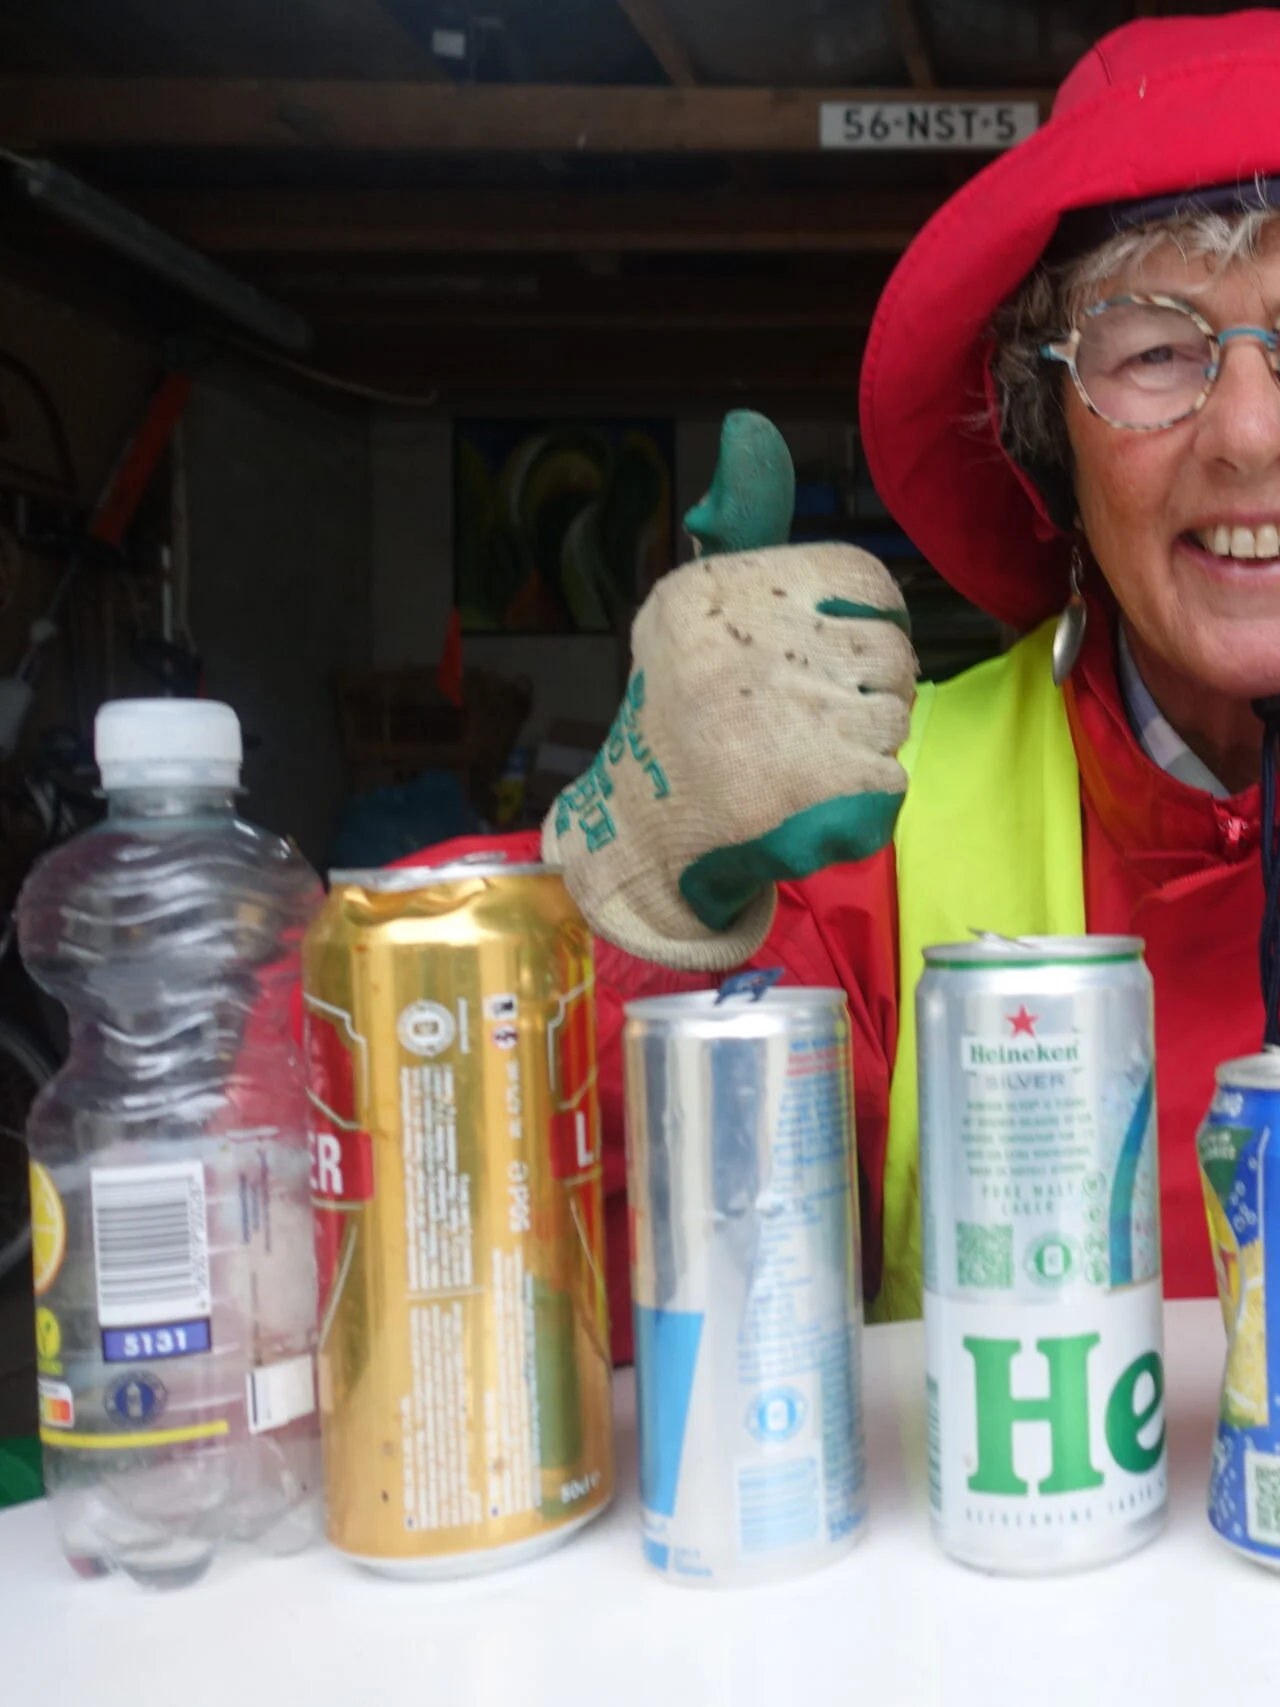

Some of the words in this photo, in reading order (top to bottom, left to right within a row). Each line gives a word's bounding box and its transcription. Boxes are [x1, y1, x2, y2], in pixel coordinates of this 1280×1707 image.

[969, 1043, 1078, 1065] Heineken
[986, 1073, 1066, 1091] SILVER
[124, 1327, 187, 1358] 5131
[962, 1331, 1166, 1497] He
